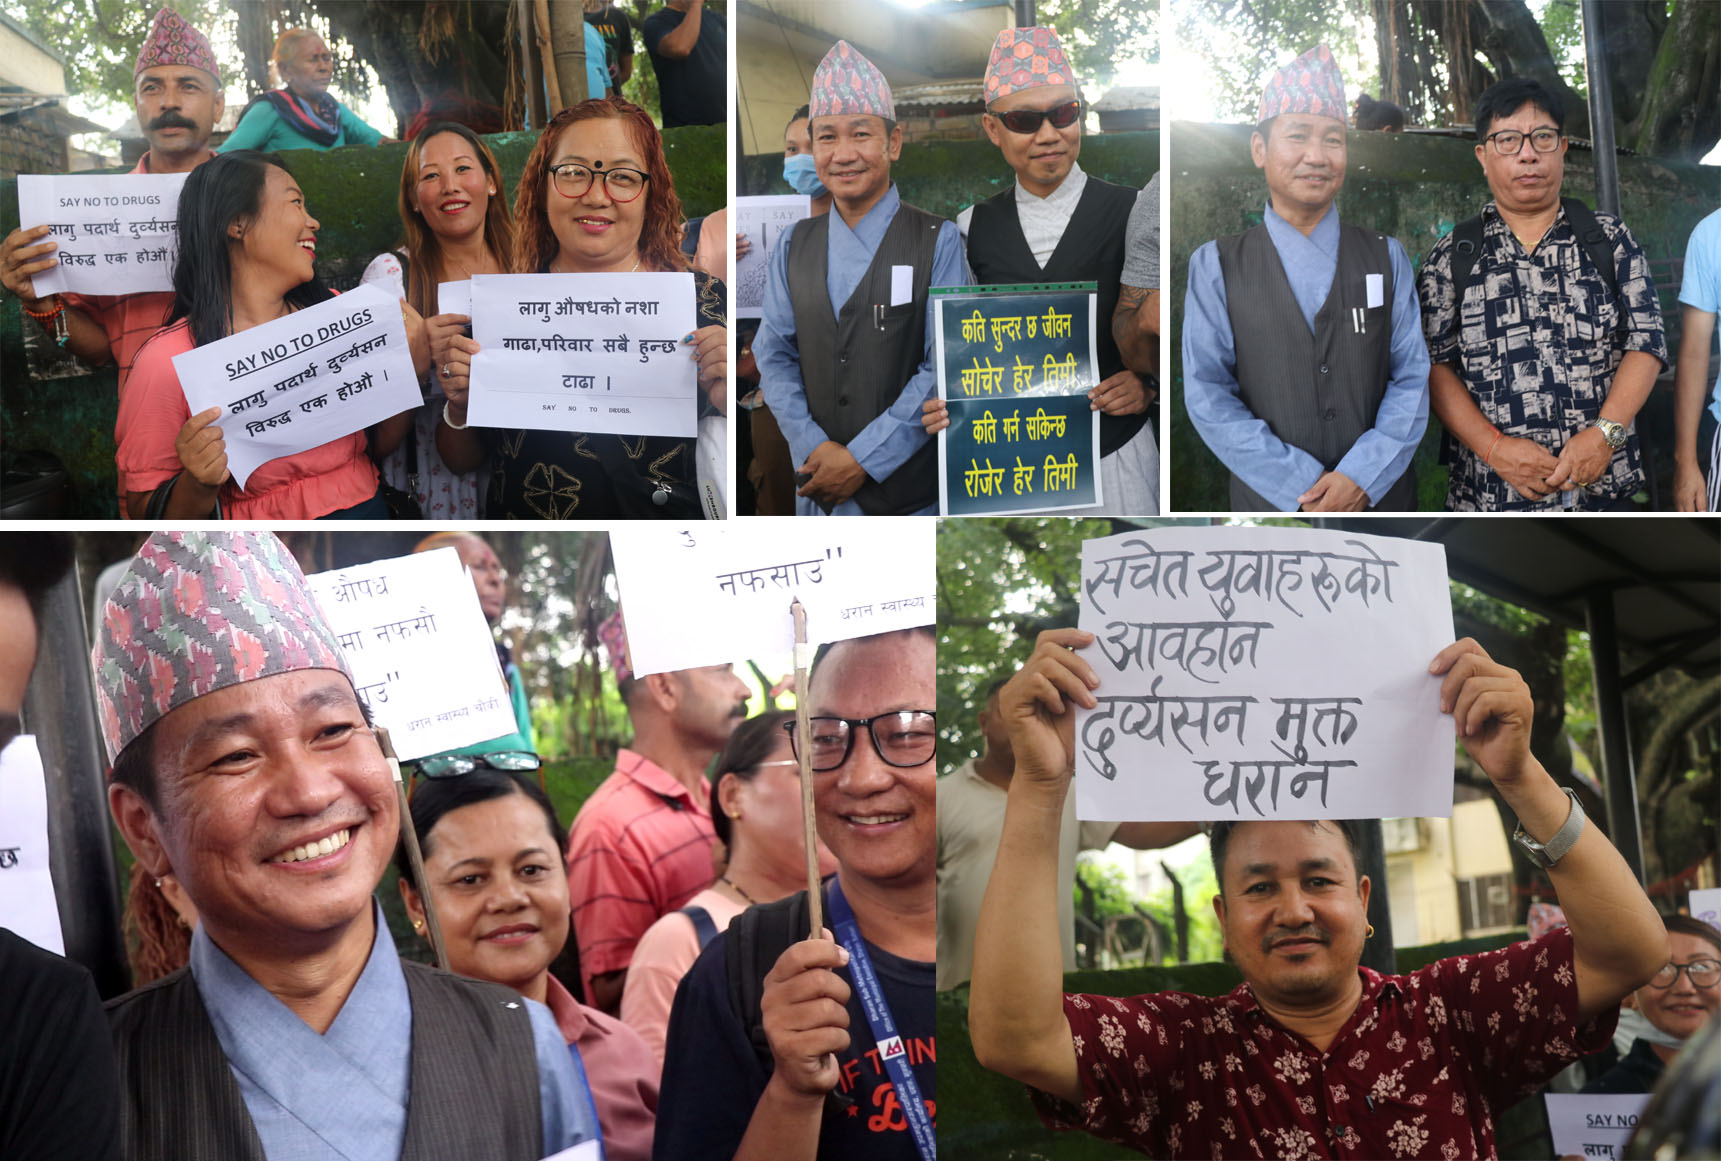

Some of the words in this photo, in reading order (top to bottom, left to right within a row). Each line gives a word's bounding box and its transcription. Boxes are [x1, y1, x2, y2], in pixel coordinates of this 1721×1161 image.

[60, 198, 81, 207] SAY
[84, 197, 101, 206] NO
[104, 197, 119, 206] TO
[122, 195, 161, 205] DRUGS
[83, 218, 121, 235] पदार्थ
[58, 251, 96, 266] विरुद्ध
[104, 252, 128, 264] एक
[519, 301, 551, 323] लागु
[554, 297, 621, 315] औषधको
[625, 301, 660, 315] नशा
[961, 309, 986, 343] कति
[990, 316, 1022, 353] सुन्दर
[1026, 316, 1038, 339] छ
[1041, 306, 1072, 339] जीवन
[225, 354, 256, 378] SAY
[261, 344, 288, 364] NO
[289, 333, 314, 352] TO
[317, 308, 372, 341] DRUGS
[602, 333, 630, 353] सबै
[639, 339, 678, 363] हुन्छ
[228, 389, 268, 415] लागु
[273, 362, 318, 393] पदार्थ
[326, 333, 388, 374] दुर्व्यसन
[562, 374, 595, 389] टाढा
[961, 356, 1005, 396] सोचेर
[1012, 354, 1035, 393] हेर
[1042, 352, 1078, 391] तिमी
[245, 410, 292, 437] विरुद्ध
[299, 393, 328, 413] एक
[972, 410, 998, 444] कति
[1002, 409, 1020, 443] गर्न
[1026, 407, 1067, 441] सकिन्छ
[964, 458, 1005, 497] रोजेर
[1013, 456, 1035, 495] हेर
[1043, 452, 1079, 492] तिमी
[1085, 539, 1195, 615] सचेत
[1270, 697, 1363, 767] मुक्त
[1586, 1114, 1613, 1127] SAY
[1617, 1115, 1639, 1127] NO
